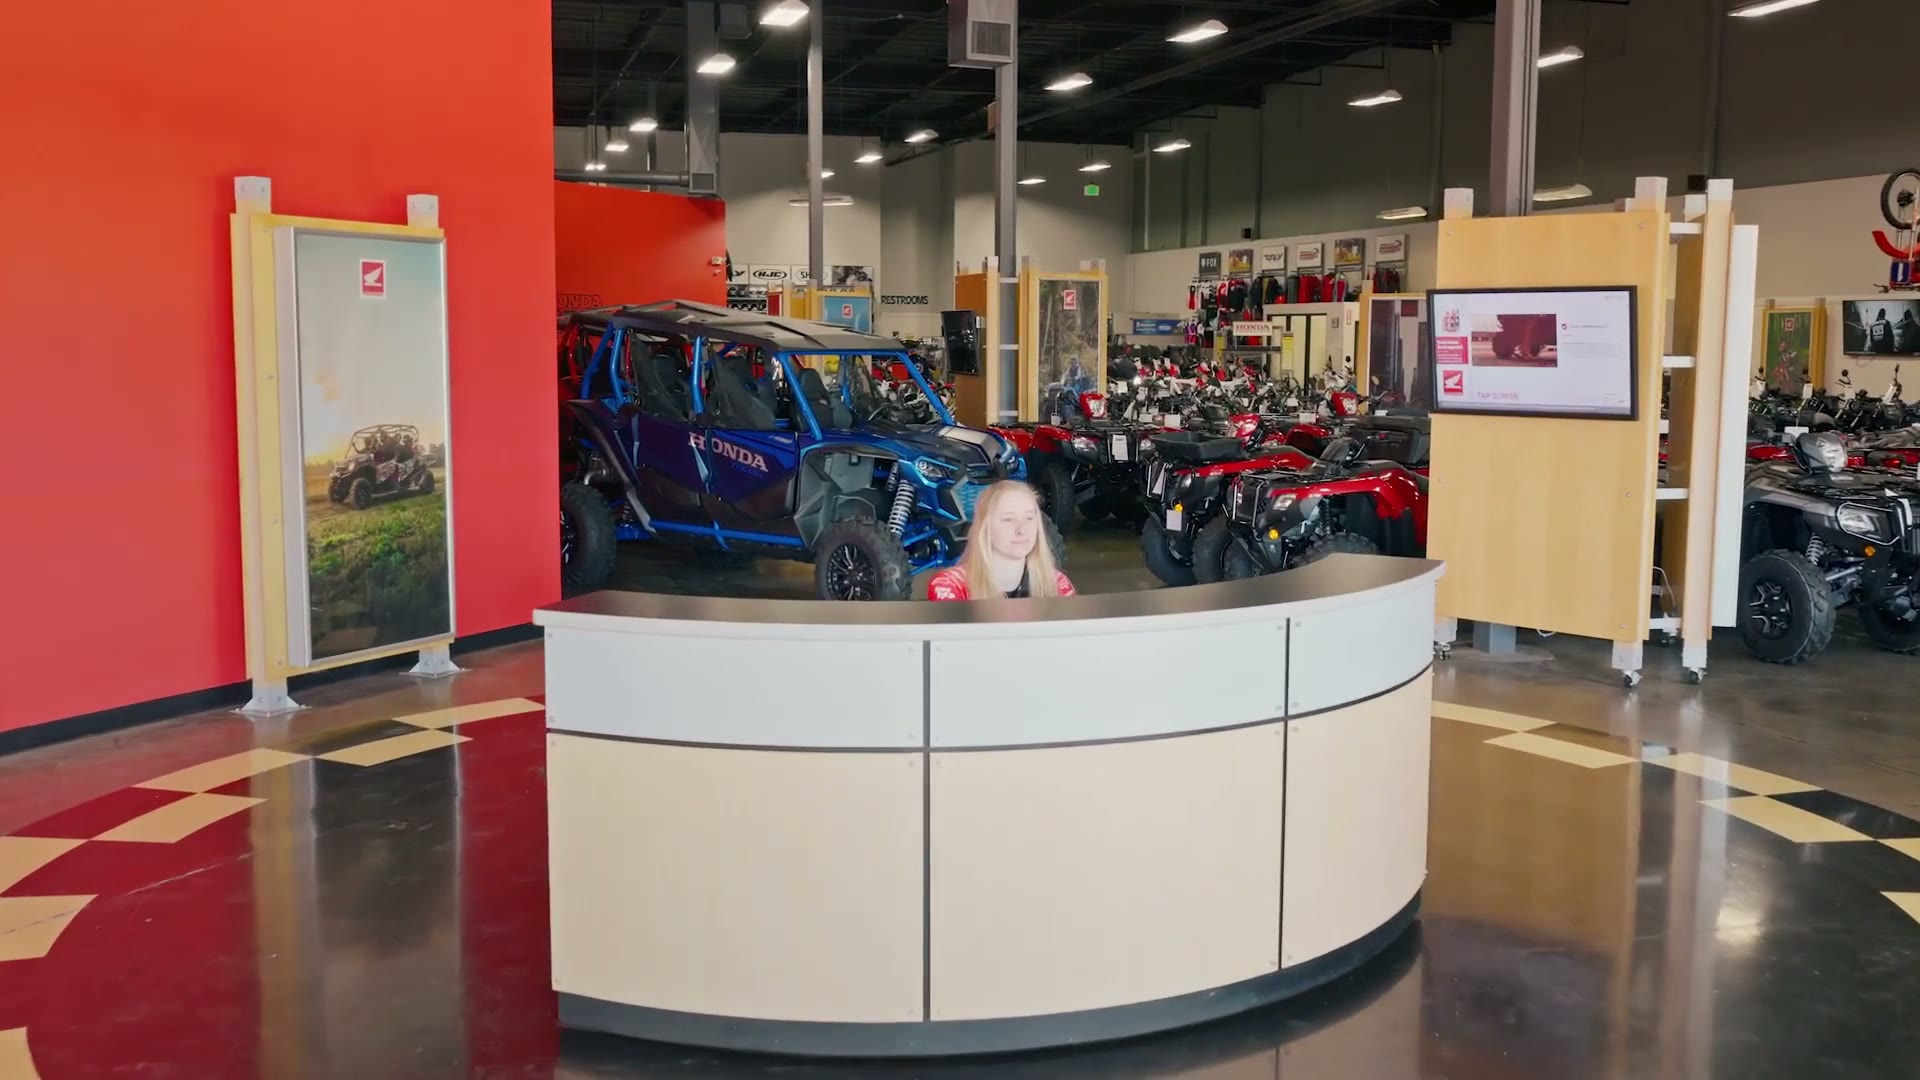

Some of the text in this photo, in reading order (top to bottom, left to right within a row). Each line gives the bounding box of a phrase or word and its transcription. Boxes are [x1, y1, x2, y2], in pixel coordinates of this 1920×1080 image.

[1206, 258, 1217, 268] FOX
[556, 293, 603, 308] ONDA
[881, 295, 929, 304] RESTROOMS
[1492, 392, 1520, 401] SCREEN
[688, 431, 768, 472] HONDA
